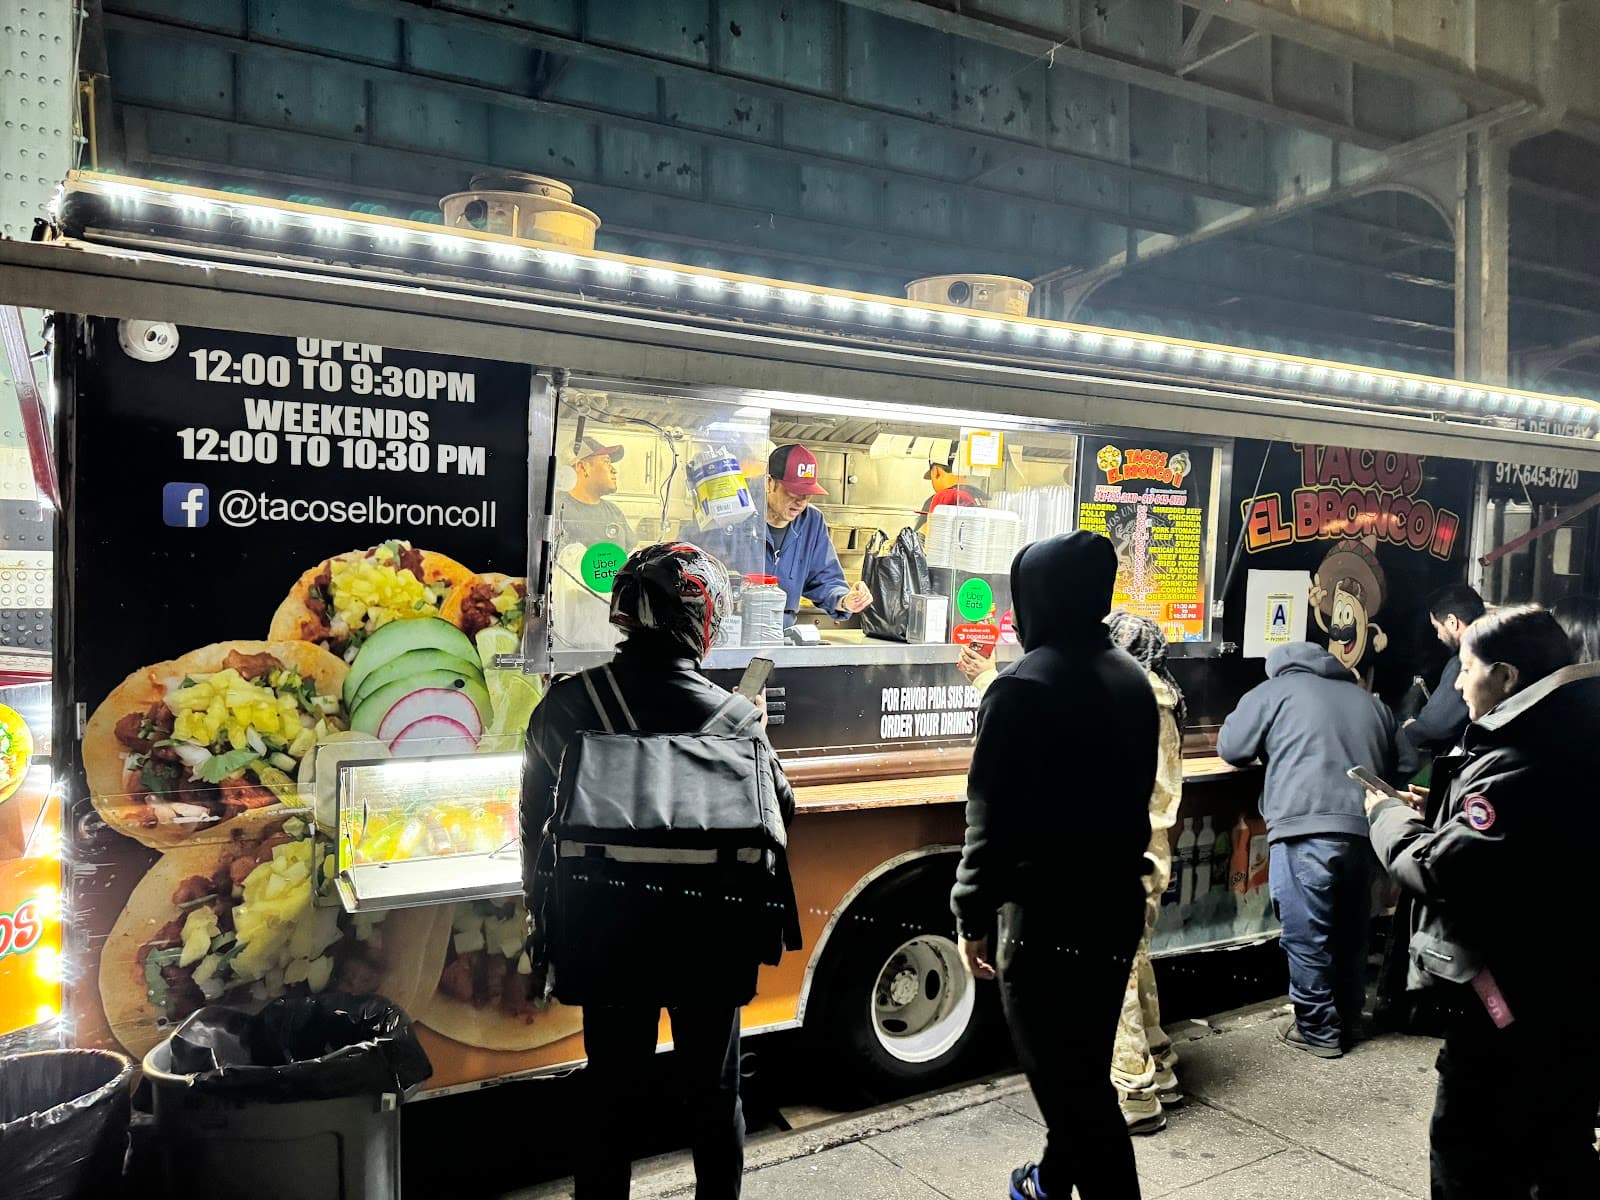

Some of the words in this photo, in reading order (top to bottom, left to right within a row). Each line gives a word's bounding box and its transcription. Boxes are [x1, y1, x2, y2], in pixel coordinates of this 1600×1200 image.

[296, 336, 383, 363] OPEN
[188, 349, 290, 388] 12:00
[298, 358, 342, 392] TO
[351, 366, 475, 403] 9:30PM
[243, 398, 430, 442] WEEKENDS
[177, 429, 278, 464] 12:00
[285, 435, 331, 468] TO
[337, 439, 430, 473] 10:30
[437, 445, 486, 476] PM
[1125, 449, 1168, 467] TACOS
[797, 463, 815, 478] CAT
[1107, 467, 1123, 484] EL
[1123, 464, 1174, 484] BRONCO
[1294, 443, 1424, 495] TACOS
[1080, 503, 1117, 511] SUADERO
[1242, 494, 1293, 553] EL
[1293, 487, 1434, 550] BRONCO
[592, 559, 617, 569] Uber
[966, 591, 984, 600] Uber
[1272, 604, 1286, 625] A
[881, 687, 900, 712] POR
[900, 686, 927, 711] FAVOR
[928, 686, 947, 710] PIDA
[947, 685, 964, 709] SUS
[881, 714, 913, 739] ORDER
[914, 713, 940, 736] YOUR
[940, 711, 974, 735] DRINKS
